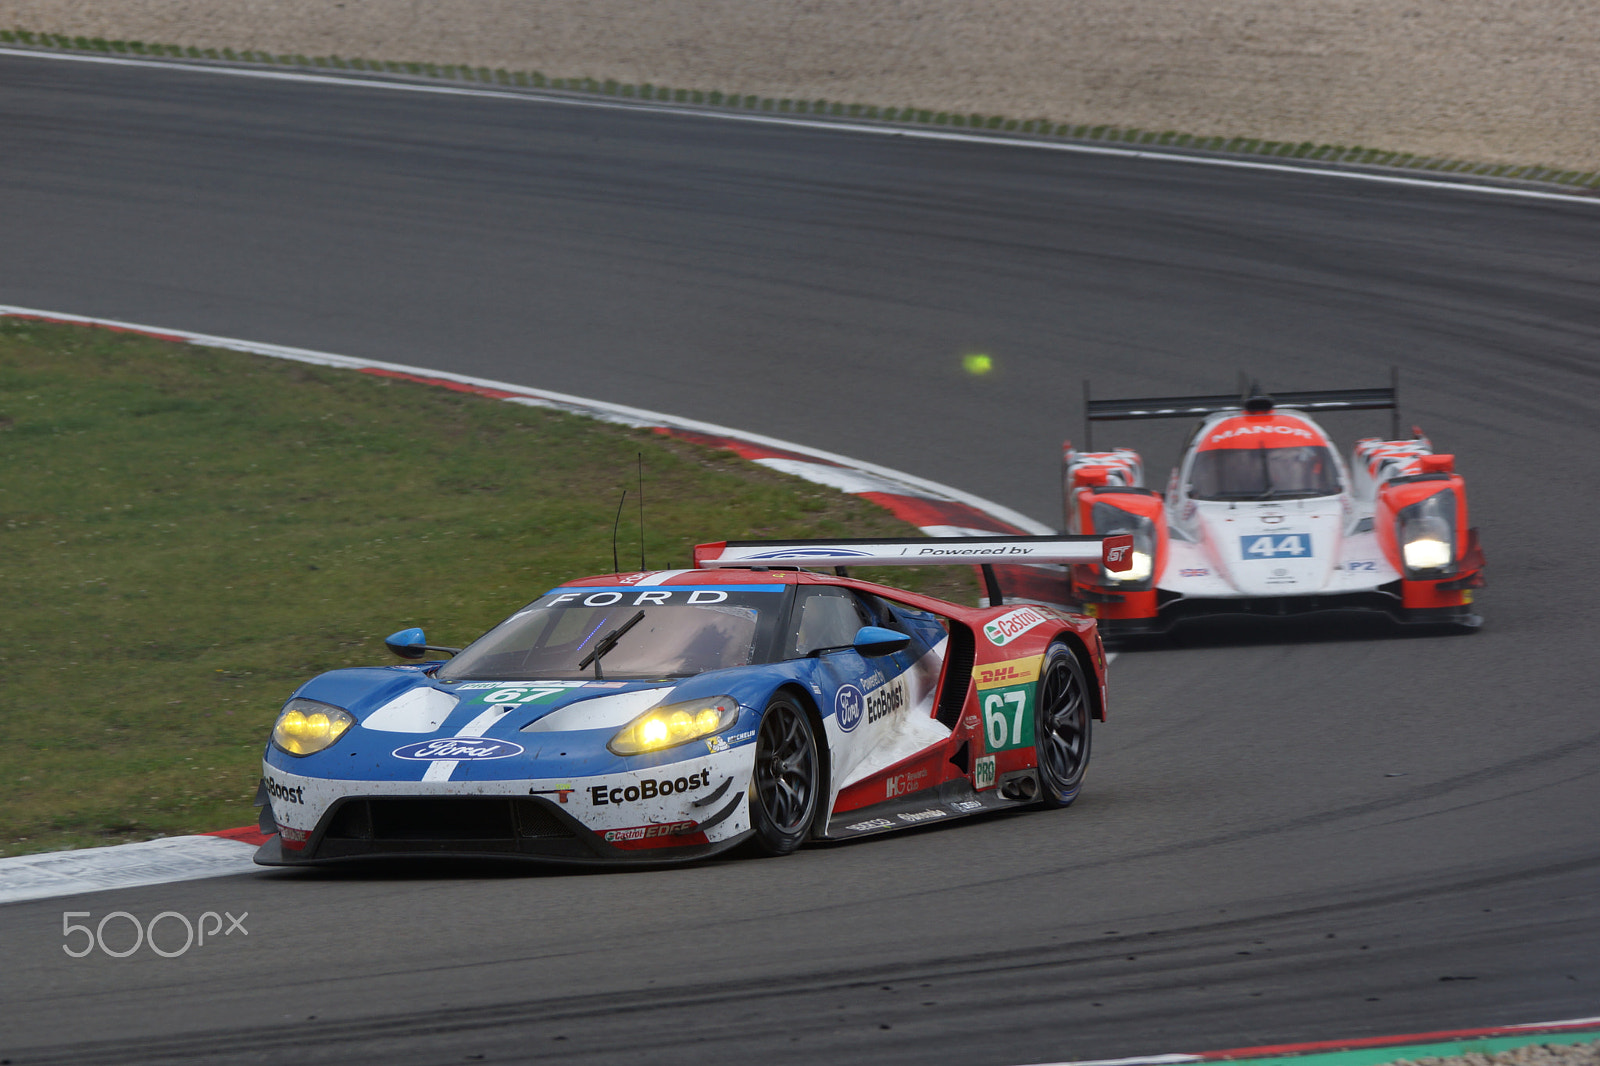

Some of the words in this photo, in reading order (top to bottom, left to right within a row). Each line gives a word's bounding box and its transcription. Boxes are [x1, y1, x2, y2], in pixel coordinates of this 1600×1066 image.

[1211, 425, 1312, 442] MANOR
[919, 547, 1000, 556] Powered
[1107, 545, 1131, 562] GT
[1247, 535, 1305, 556] 44
[1349, 561, 1377, 571] P2
[547, 590, 728, 607] FORD
[998, 609, 1041, 637] Castrol
[980, 666, 1019, 683] DHL
[483, 688, 565, 703] 67
[840, 690, 860, 725] Ford
[867, 685, 903, 724] EcoBoost
[985, 690, 1026, 748] 67
[414, 740, 500, 758] Ford
[976, 761, 995, 784] PRO
[591, 768, 710, 805] EcoBoost
[886, 775, 905, 798] IHG
[907, 781, 919, 792] Club
[615, 830, 643, 840] Castrol
